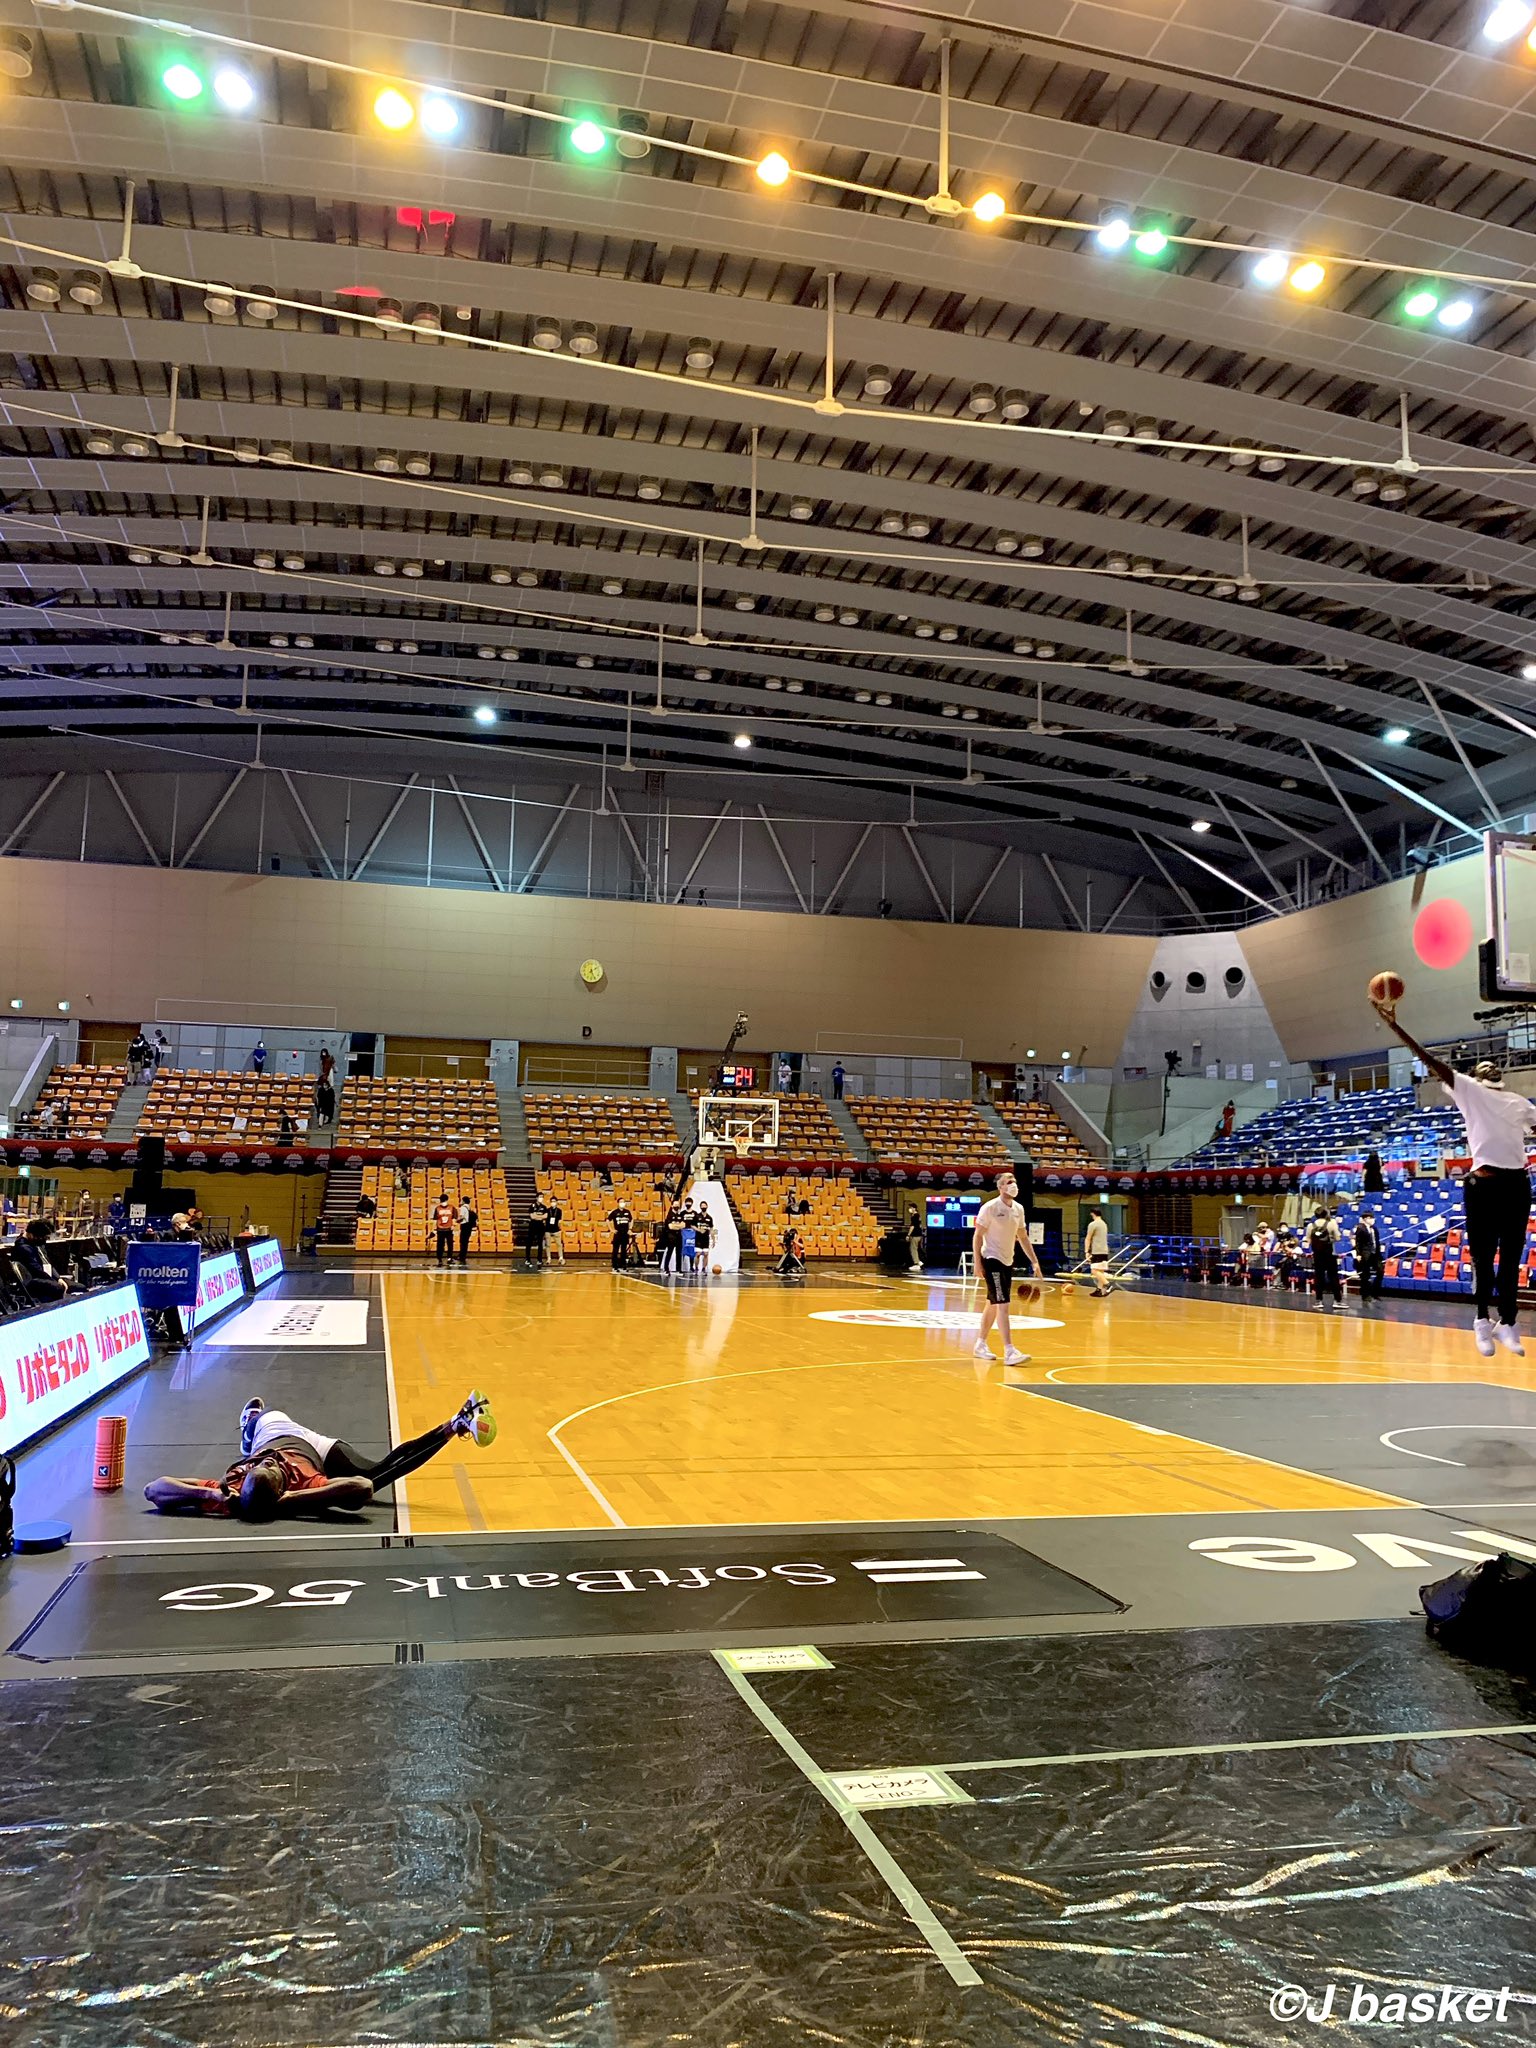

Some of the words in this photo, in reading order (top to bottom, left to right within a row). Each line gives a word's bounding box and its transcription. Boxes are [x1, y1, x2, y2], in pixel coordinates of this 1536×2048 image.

[582, 1026, 592, 1037] D
[735, 1067, 753, 1086] 24
[138, 1266, 188, 1278] molten
[16, 1332, 90, 1404] リポビタンD
[94, 1310, 141, 1363] リポビタンD
[386, 1562, 837, 1599] SoftBank
[158, 1580, 367, 1611] 5G
[843, 1778, 928, 1791] テレビカメラ
